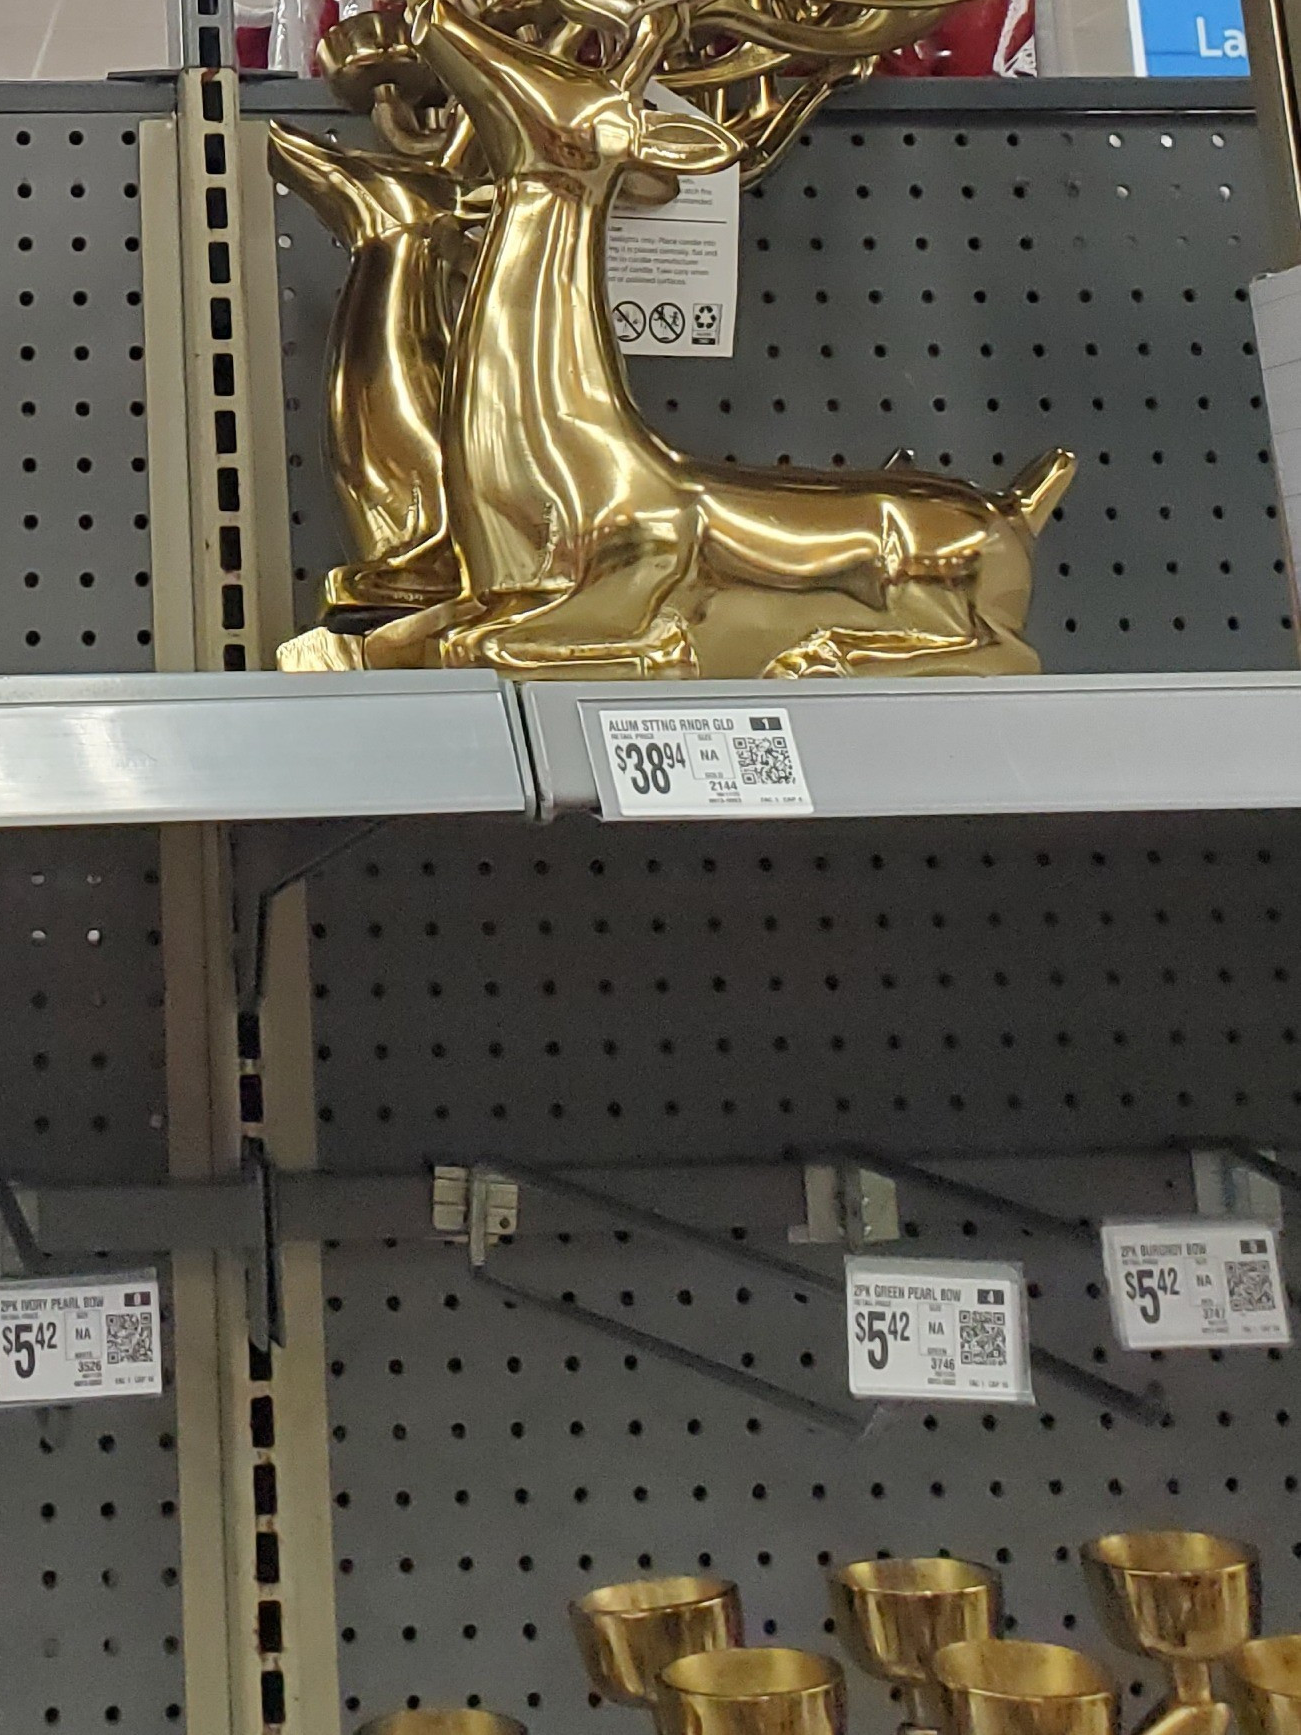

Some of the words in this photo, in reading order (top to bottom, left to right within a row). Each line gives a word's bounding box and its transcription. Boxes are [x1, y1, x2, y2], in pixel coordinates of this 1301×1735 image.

[1196, 16, 1248, 59] La
[609, 719, 639, 732] ALUM
[642, 720, 677, 731] STTNG
[681, 719, 710, 731] RNDR
[713, 719, 734, 731] GLD
[700, 750, 719, 761] NA
[710, 781, 738, 791] 2144
[875, 1285, 905, 1299] GREEN
[908, 1287, 937, 1301] PEARL
[51, 1297, 80, 1310] PEARL
[75, 1328, 91, 1340] NA
[929, 1322, 944, 1335] NA
